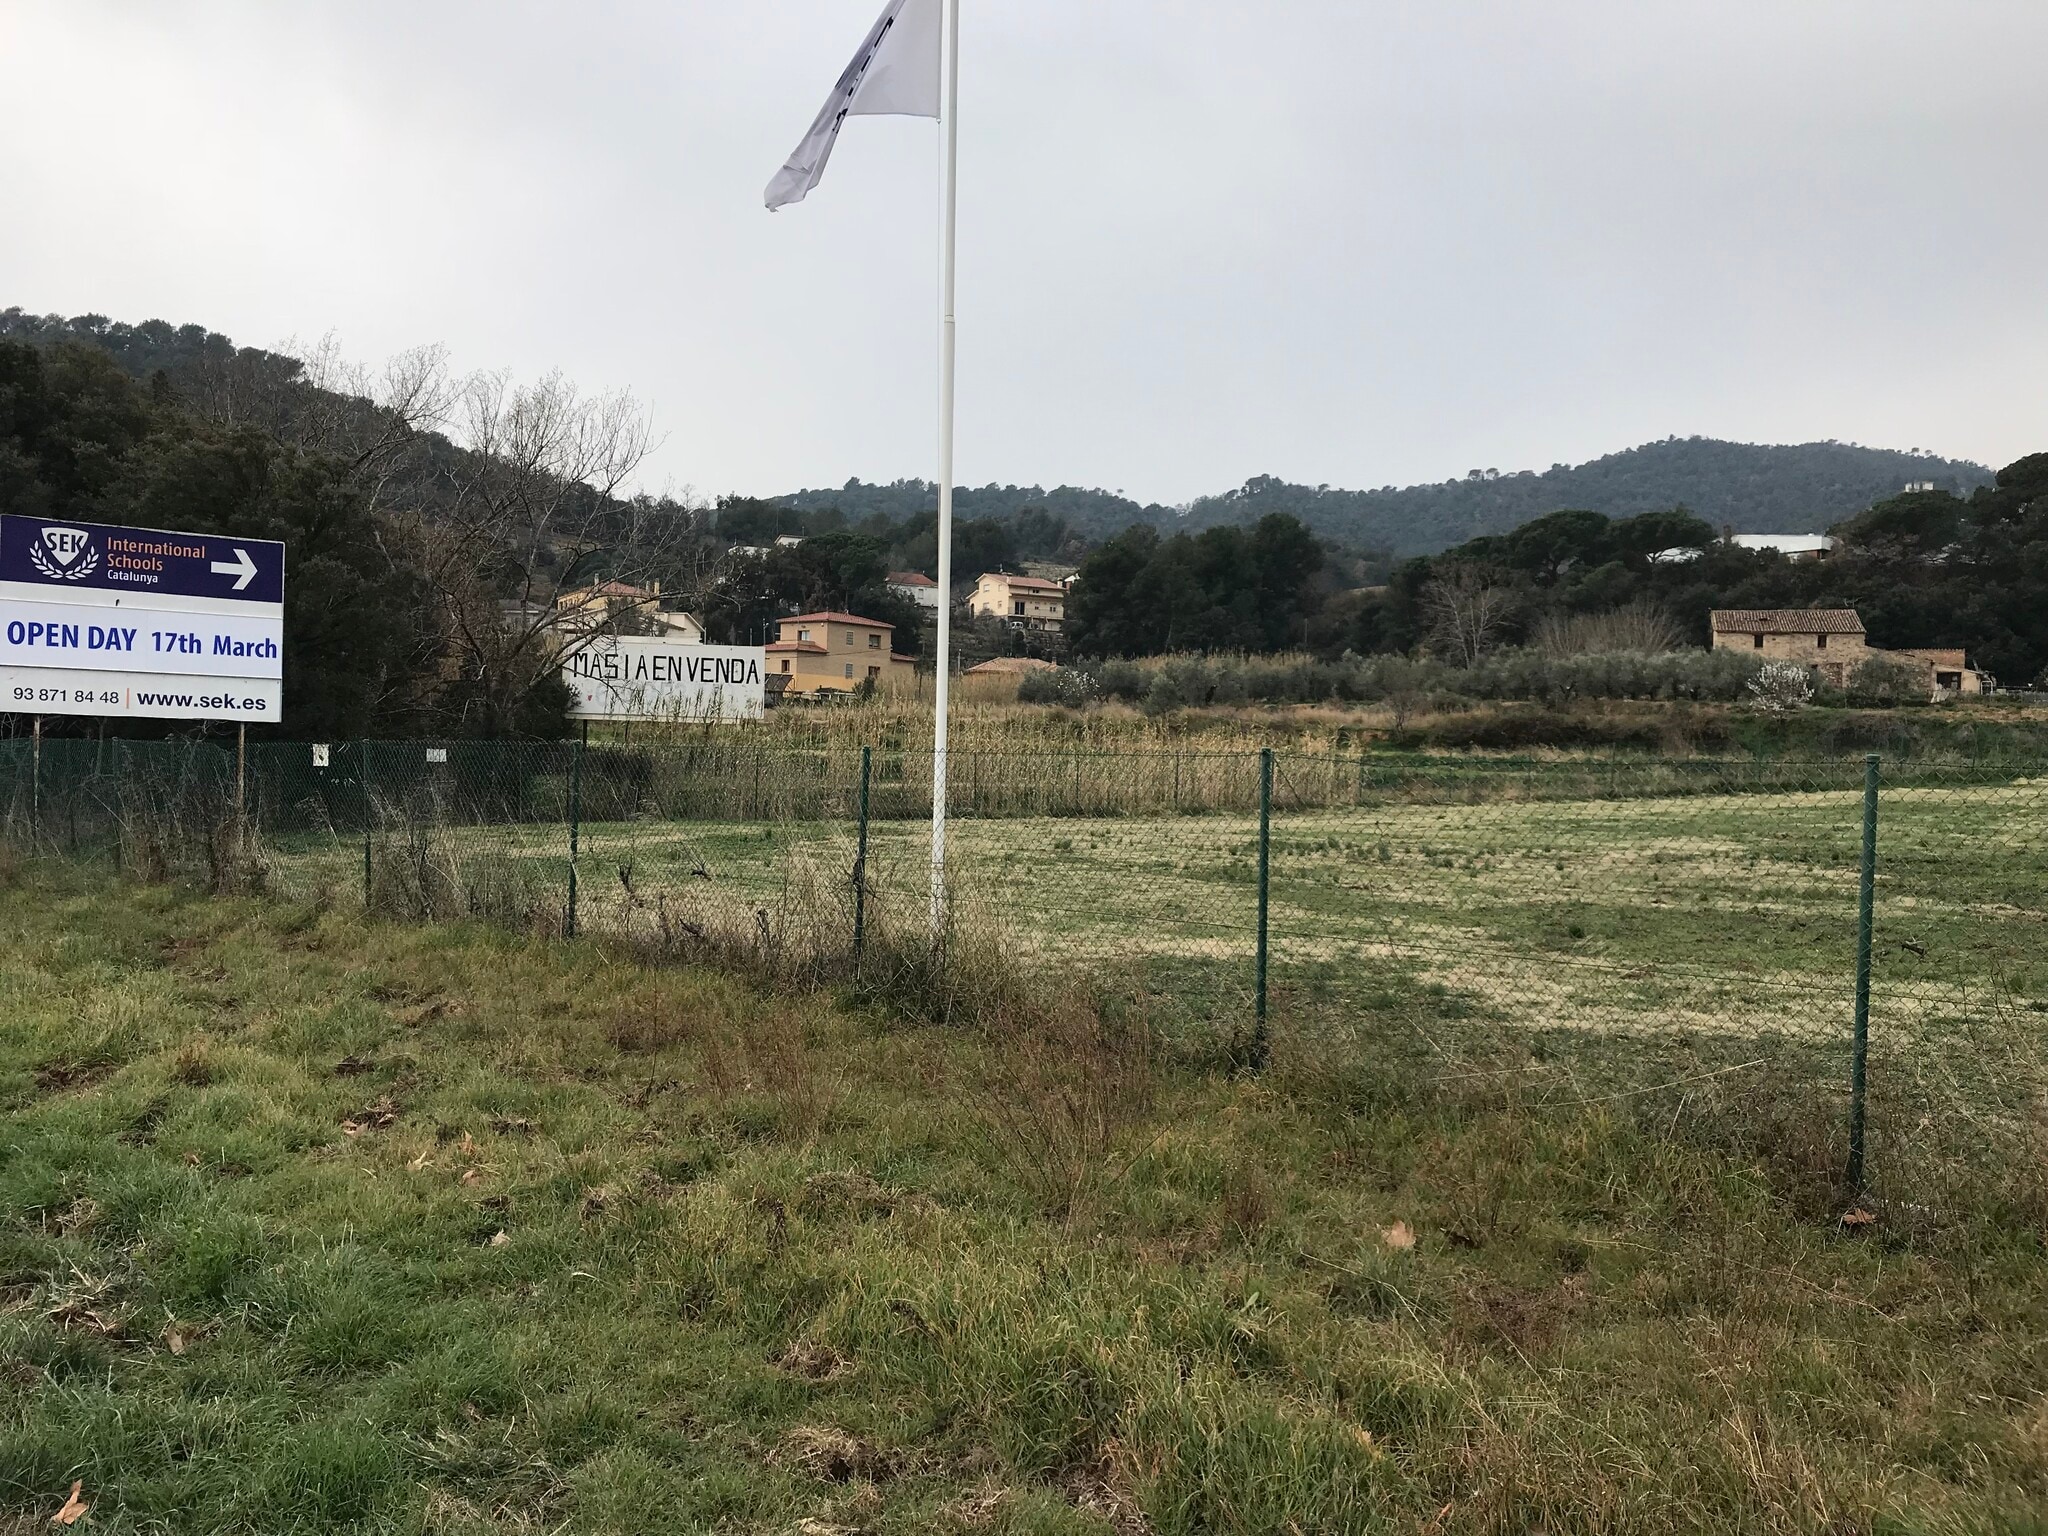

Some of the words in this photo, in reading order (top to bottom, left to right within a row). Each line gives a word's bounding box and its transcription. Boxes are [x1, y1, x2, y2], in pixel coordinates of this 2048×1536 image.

[47, 532, 84, 554] SEK
[107, 536, 206, 559] International
[107, 553, 163, 571] Schools
[107, 569, 159, 584] Catalunya
[7, 620, 79, 649] OPEN
[88, 626, 137, 651] DAY
[151, 631, 202, 654] 17th
[213, 635, 278, 658] March
[686, 656, 760, 684] VENDA
[13, 687, 34, 701] 93
[39, 688, 67, 702] 871
[74, 690, 94, 703] 84
[99, 691, 119, 704] 48
[137, 691, 267, 710] www.sek.es
